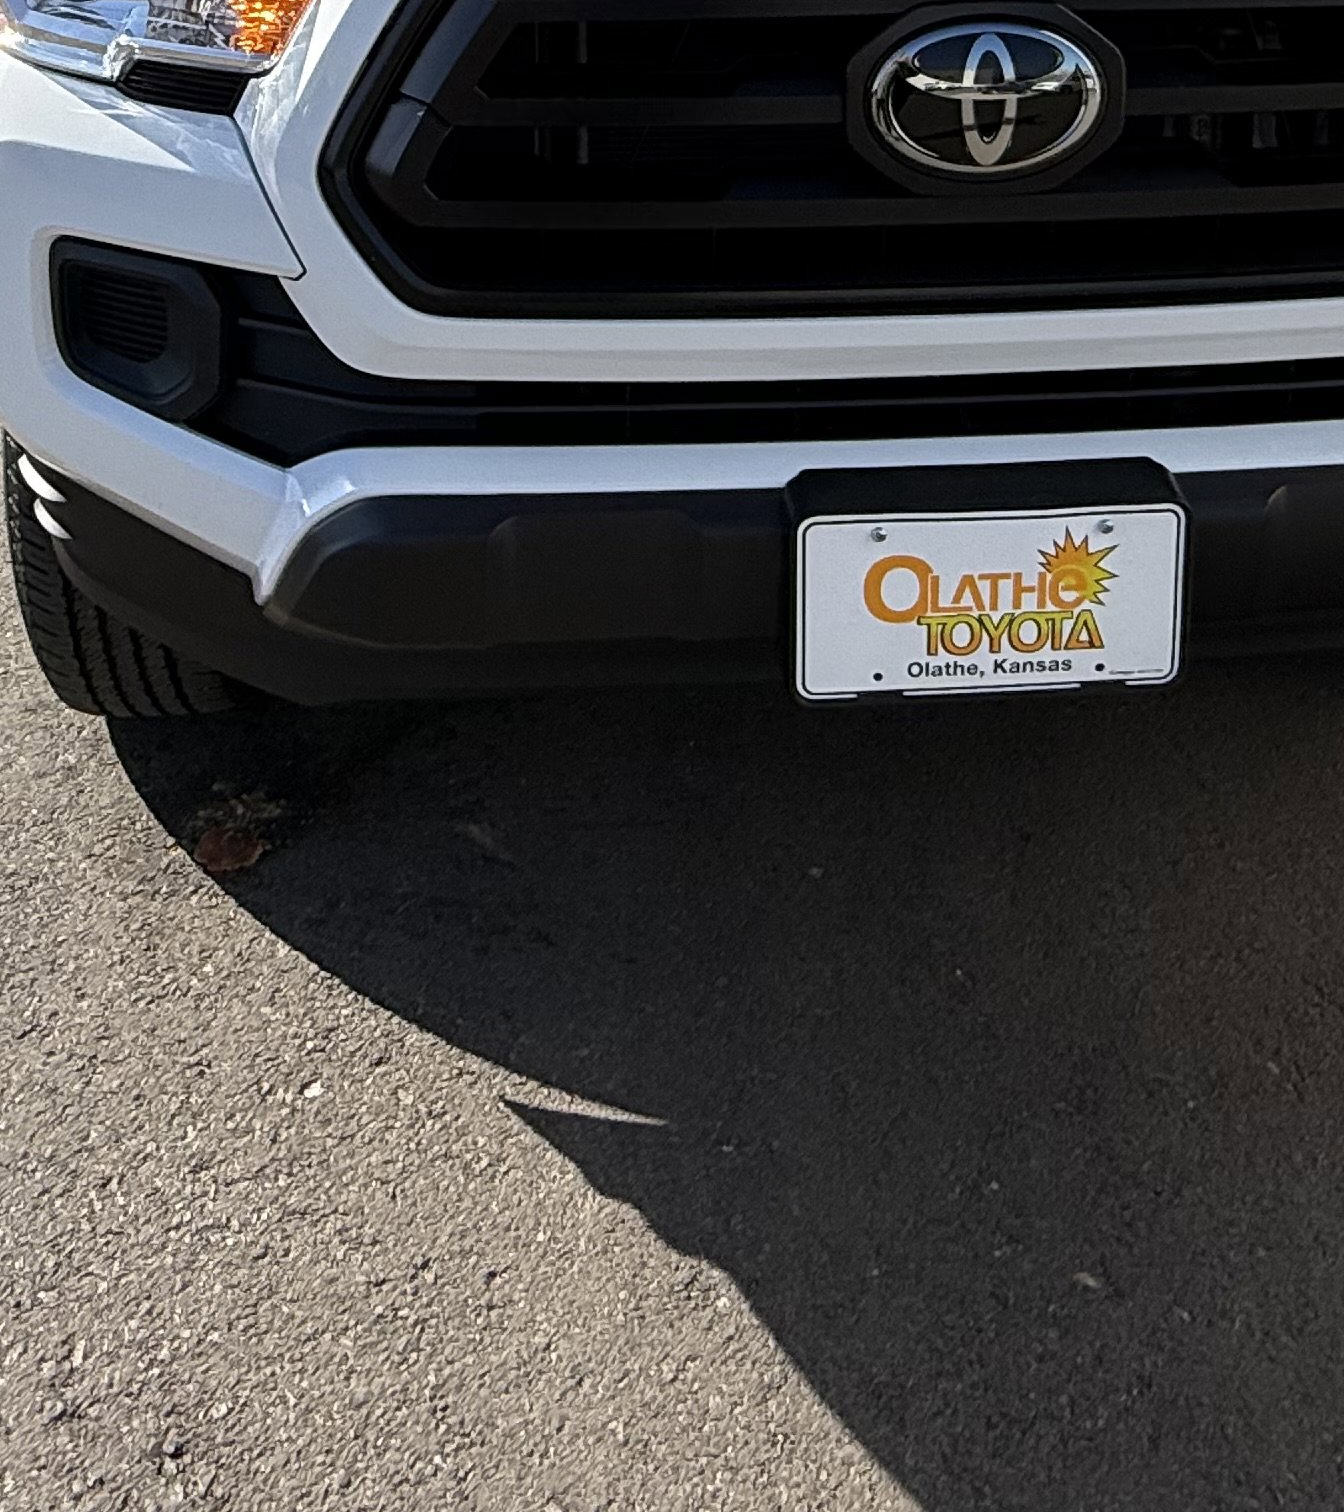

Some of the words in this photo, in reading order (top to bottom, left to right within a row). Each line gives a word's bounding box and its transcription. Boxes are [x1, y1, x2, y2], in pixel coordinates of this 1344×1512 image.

[916, 608, 1105, 657] TOYOTA
[907, 660, 985, 678] Olathe,
[992, 658, 1072, 675] Kansas
